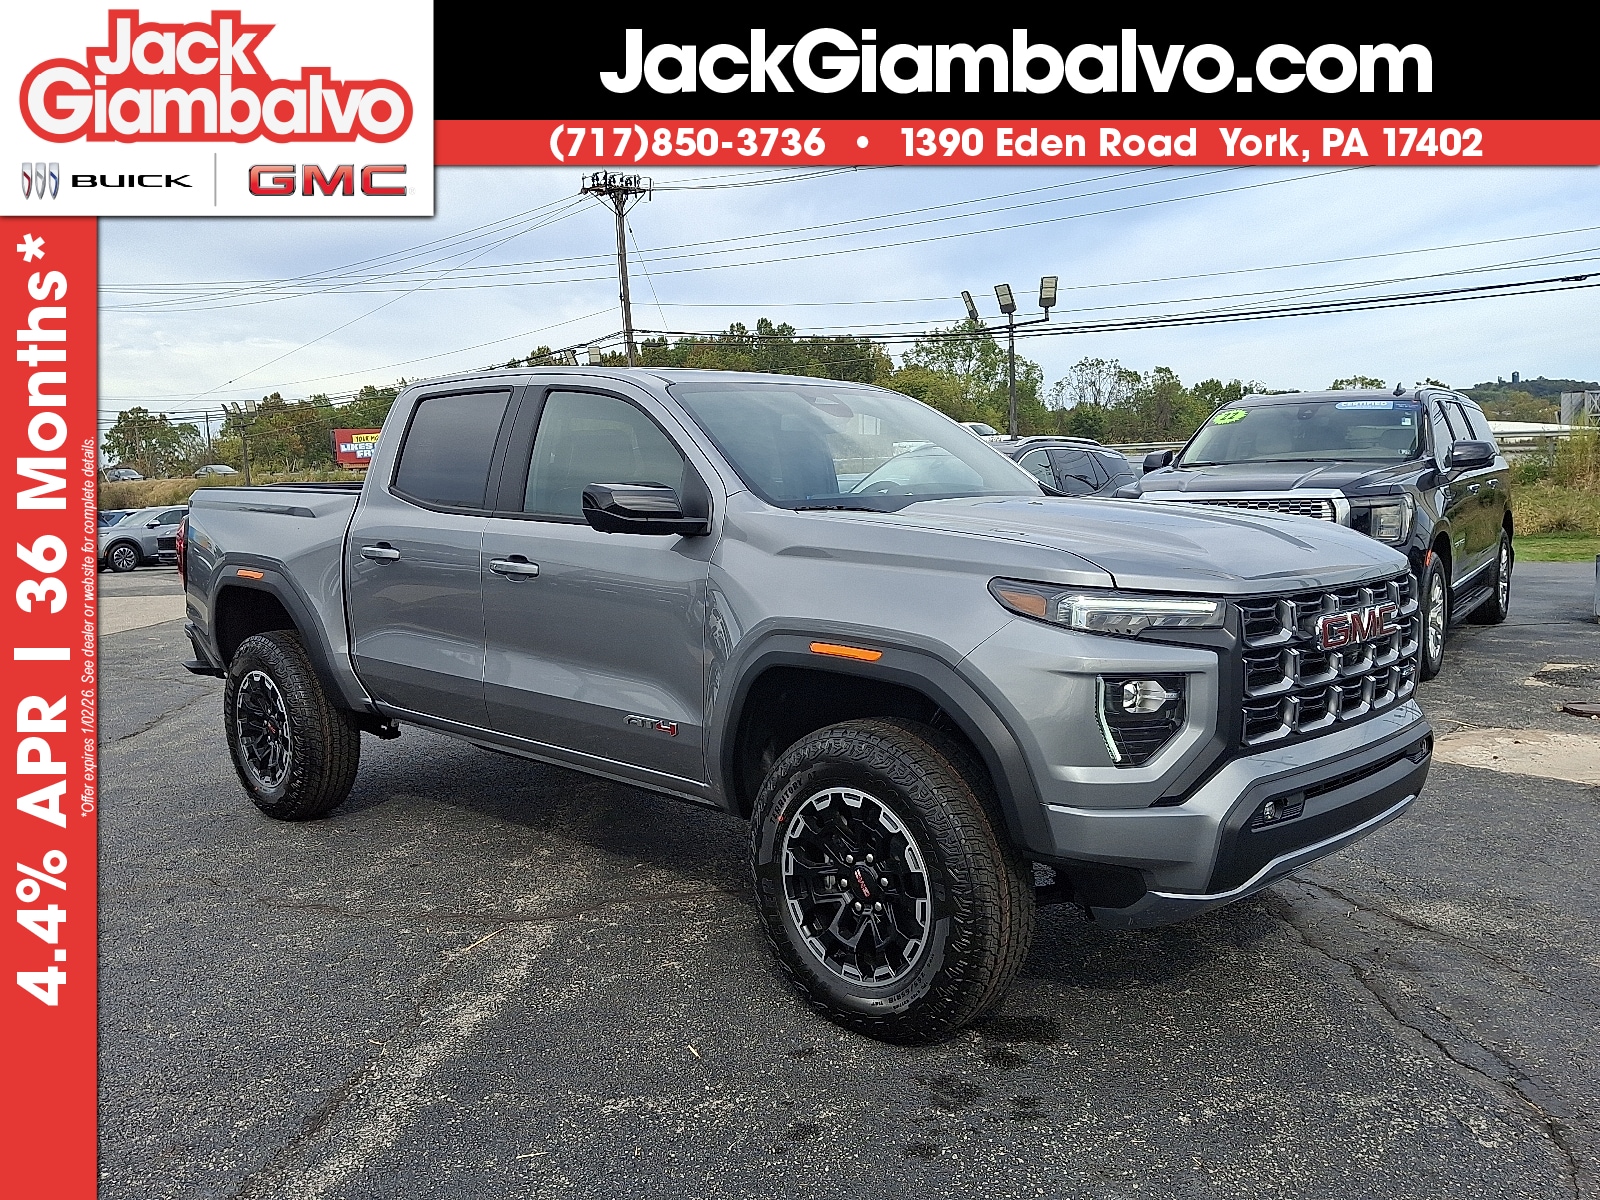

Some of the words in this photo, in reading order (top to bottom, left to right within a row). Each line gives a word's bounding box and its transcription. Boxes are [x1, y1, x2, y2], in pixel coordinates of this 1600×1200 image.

[340, 443, 373, 452] LIKES
[1315, 601, 1401, 651] GMC
[622, 714, 679, 737] AT4
[770, 778, 802, 824] TERRITORY
